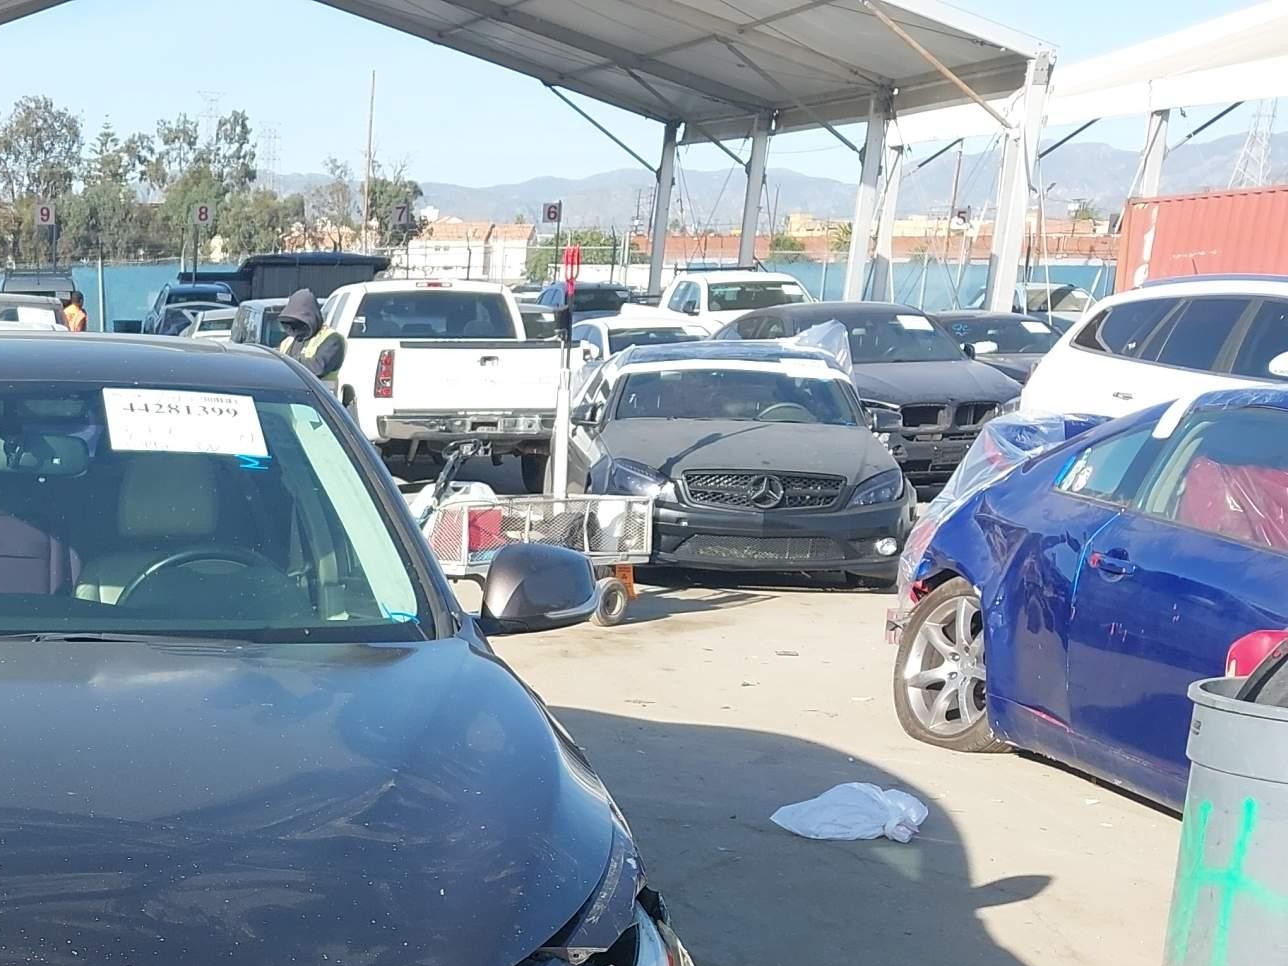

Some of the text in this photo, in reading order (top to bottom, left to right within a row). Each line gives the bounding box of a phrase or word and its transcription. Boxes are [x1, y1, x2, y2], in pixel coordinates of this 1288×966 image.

[40, 206, 50, 222] 9
[198, 206, 208, 221] 8
[395, 205, 406, 222] 7
[547, 205, 558, 220] 6
[956, 210, 967, 226] 5
[122, 401, 239, 418] 44281399
